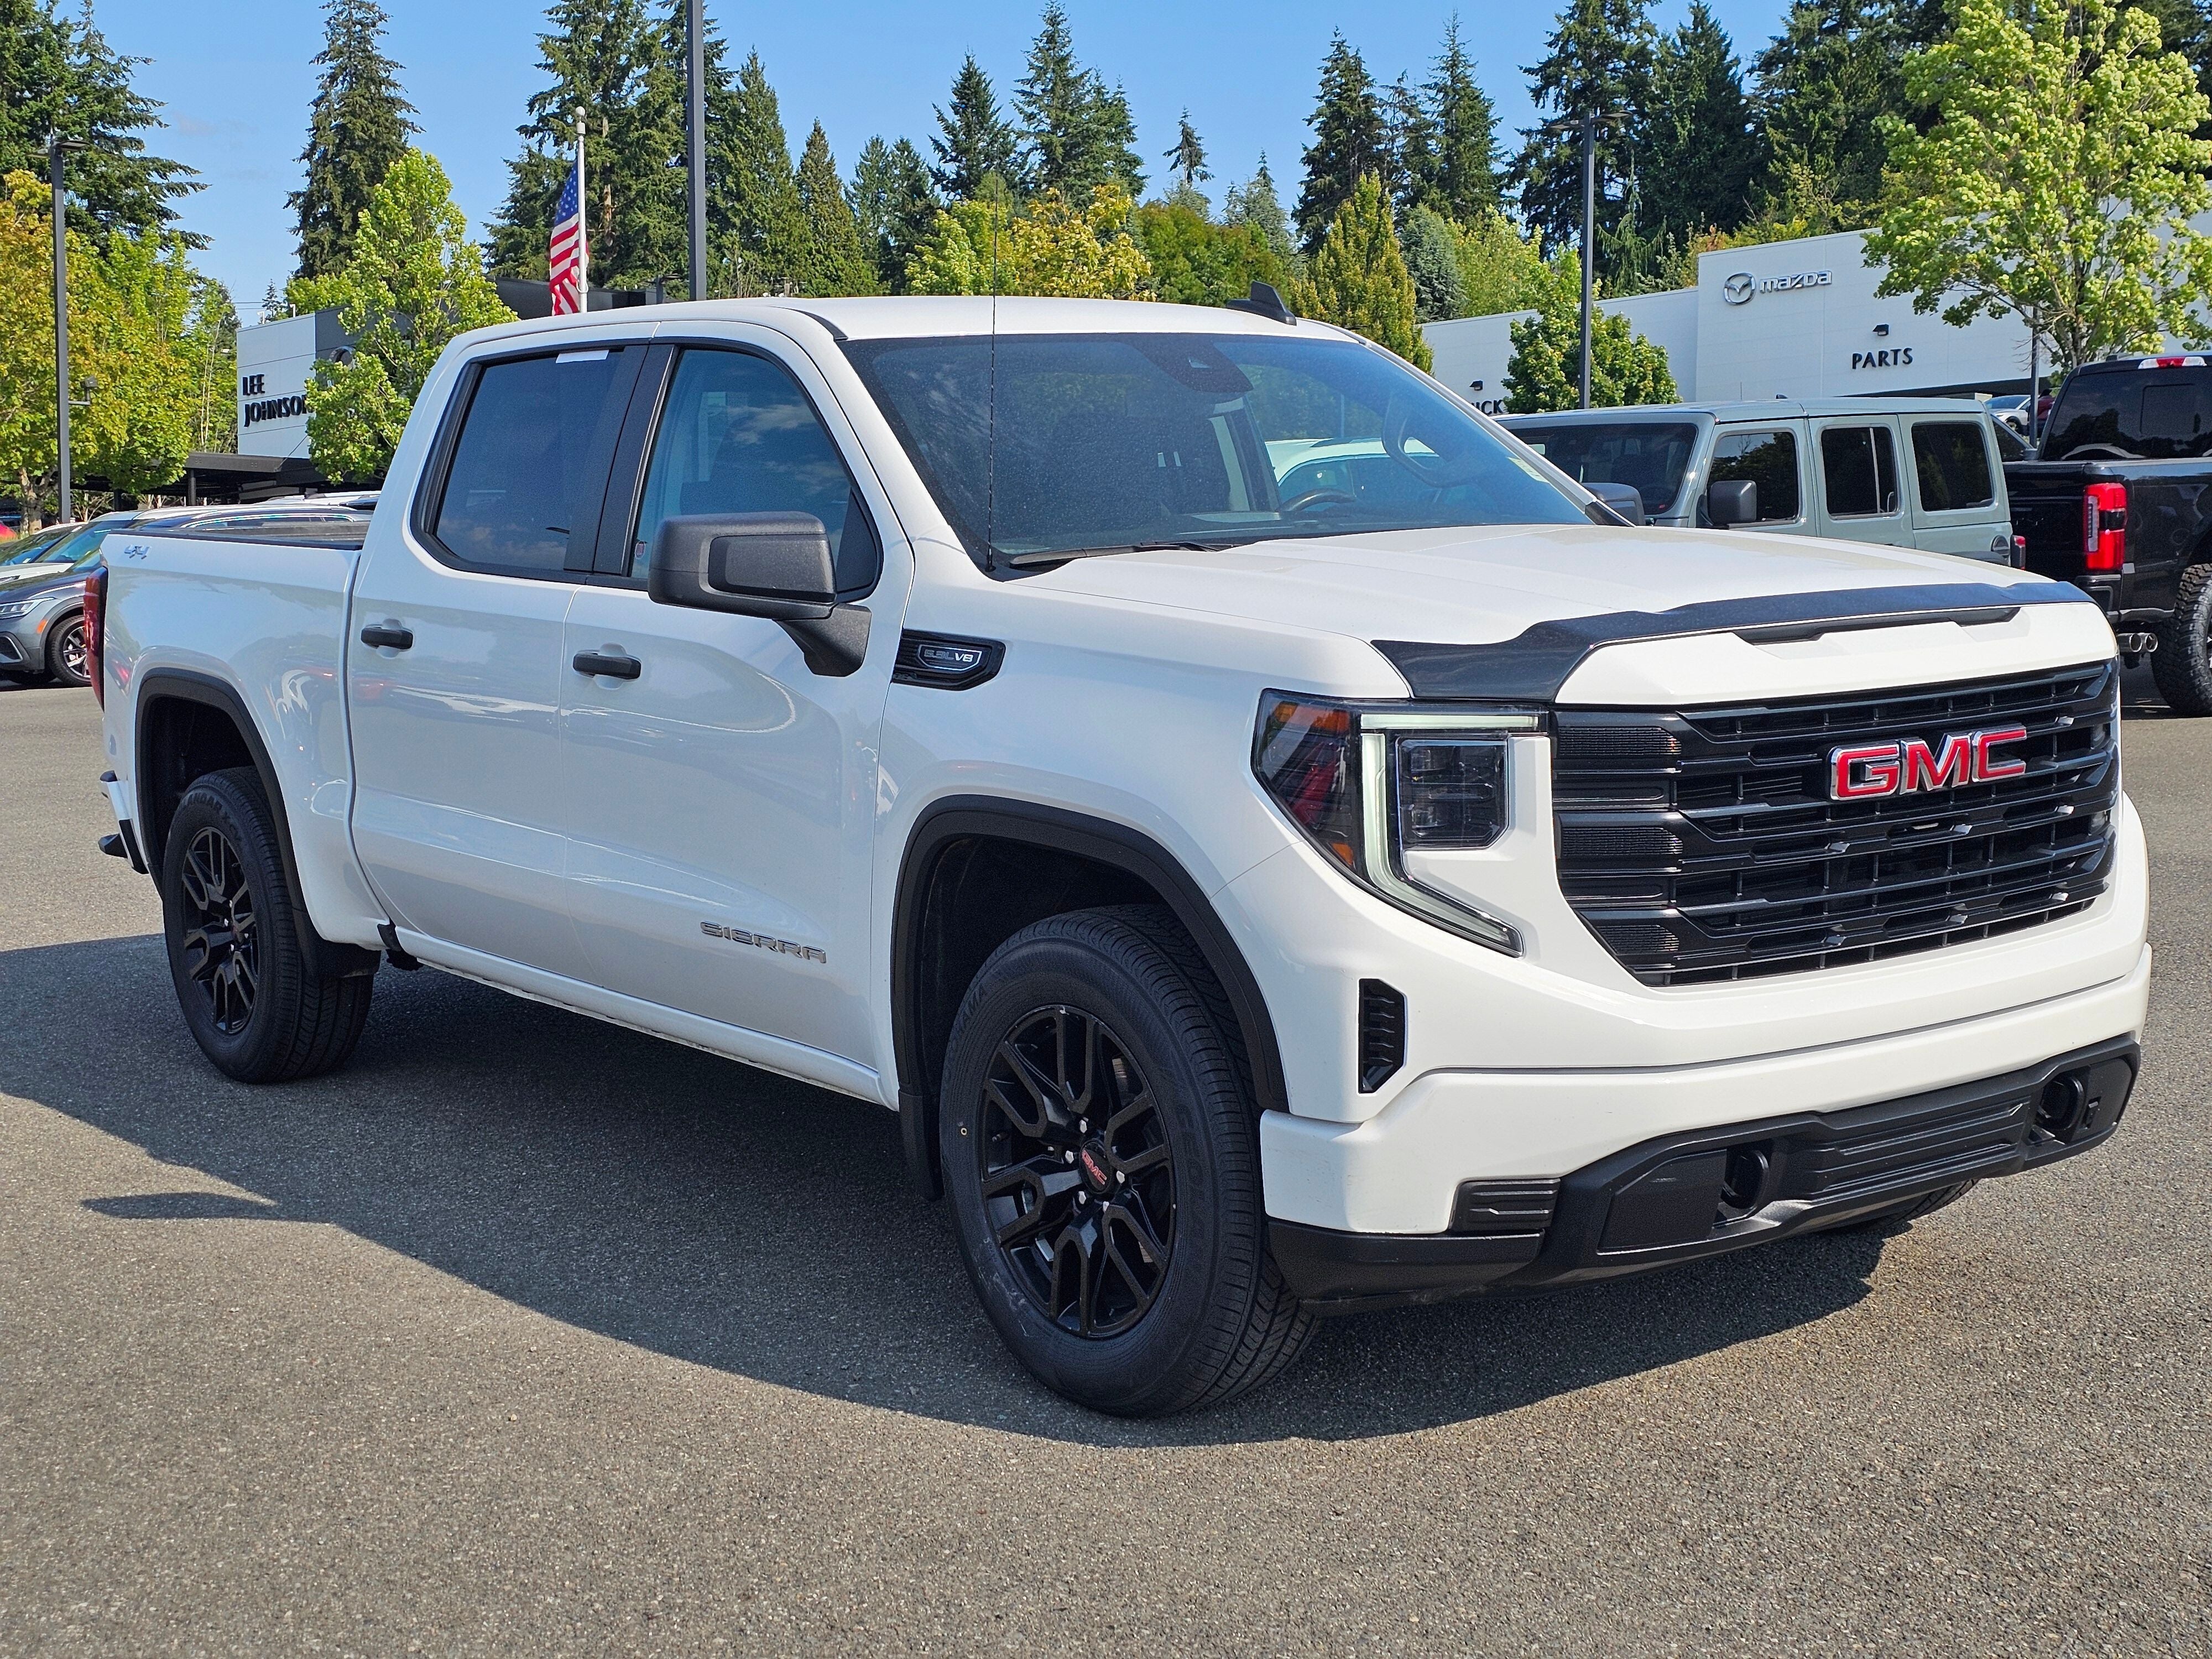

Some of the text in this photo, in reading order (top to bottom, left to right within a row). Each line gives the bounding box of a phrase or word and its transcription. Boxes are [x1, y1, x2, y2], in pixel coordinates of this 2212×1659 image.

[1852, 347, 1913, 369] PARTS
[242, 374, 265, 395] LEE
[954, 653, 974, 662] V8
[1829, 723, 2027, 801] GMC
[700, 921, 827, 964] SIERRA
[1082, 1150, 1107, 1185] GMC
